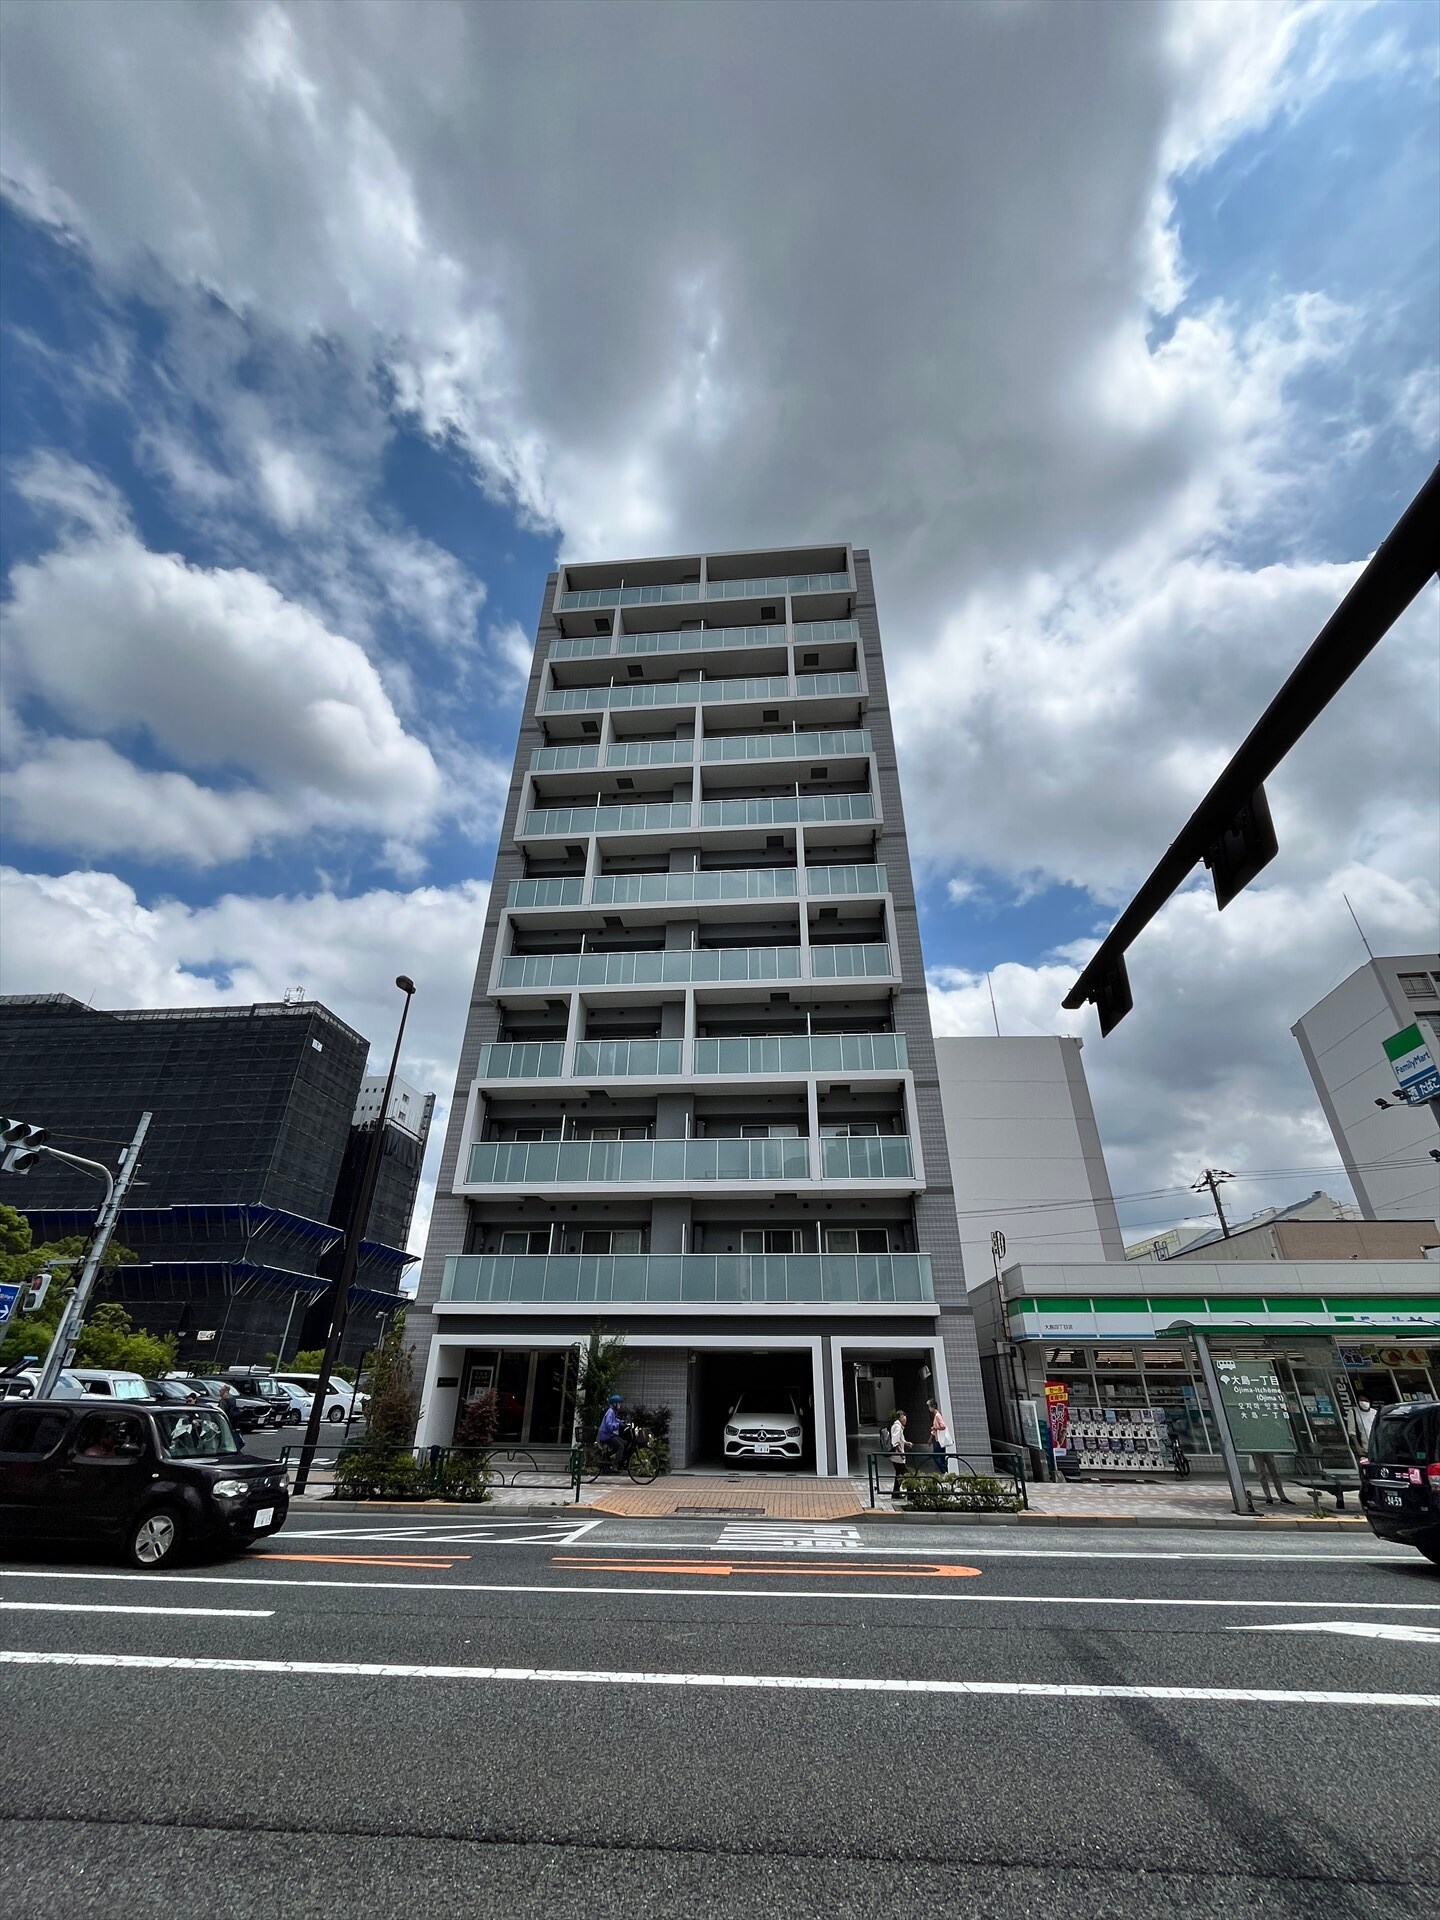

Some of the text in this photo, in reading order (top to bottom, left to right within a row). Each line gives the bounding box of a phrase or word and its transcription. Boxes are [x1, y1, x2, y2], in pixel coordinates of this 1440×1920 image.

[1395, 1051, 1430, 1075] FamilyMart
[1419, 1077, 1440, 1095] たばこ
[1231, 1375, 1279, 1386] 大島一丁目
